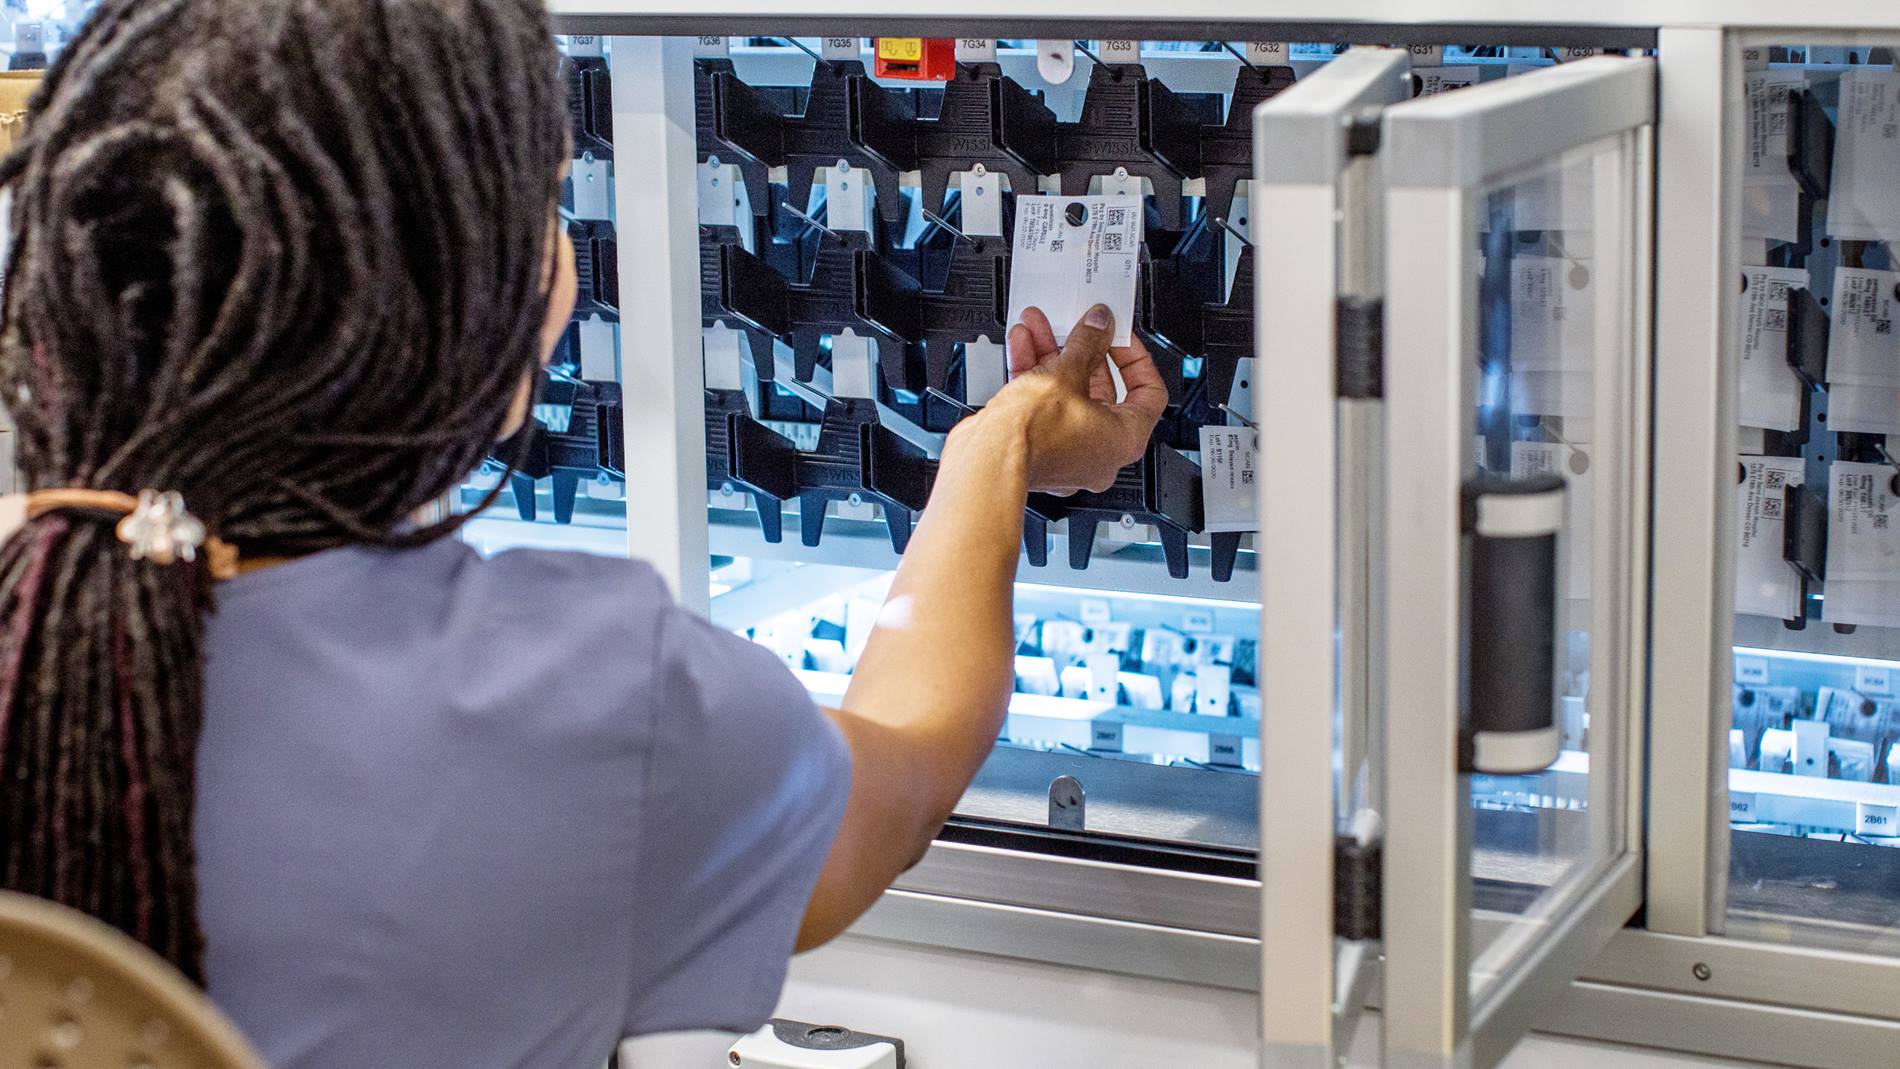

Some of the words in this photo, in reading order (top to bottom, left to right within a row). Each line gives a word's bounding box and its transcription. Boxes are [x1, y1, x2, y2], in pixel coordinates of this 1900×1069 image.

[573, 36, 594, 45] 7G37
[698, 37, 721, 46] 7G36
[829, 39, 851, 48] 7G35
[962, 40, 986, 49] 7G34
[1106, 41, 1131, 51] 7G33
[1254, 43, 1280, 53] 7G32
[1407, 45, 1433, 55] 7G31
[1566, 47, 1593, 57] 7G30
[1087, 259, 1092, 267] CO
[1864, 814, 1888, 825] 2B61
